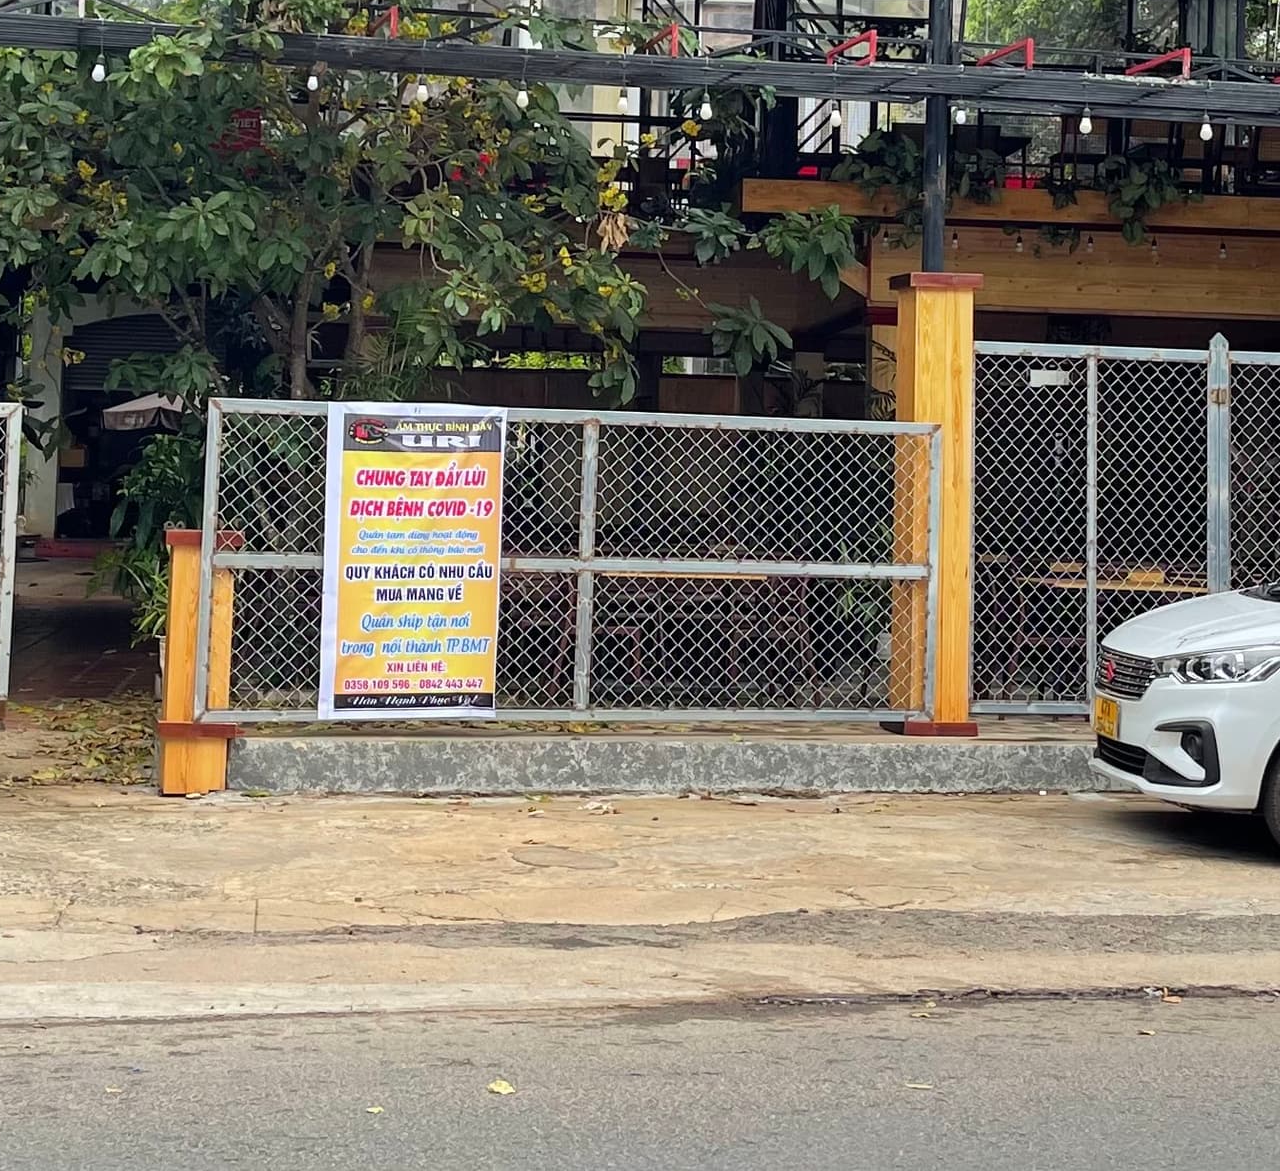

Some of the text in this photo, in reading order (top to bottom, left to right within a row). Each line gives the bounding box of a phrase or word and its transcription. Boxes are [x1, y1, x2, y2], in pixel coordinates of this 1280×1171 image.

[445, 421, 469, 432] BÌNH
[401, 435, 481, 448] URI
[356, 462, 486, 486] CHUNG TAY ĐẨY LÙI
[350, 500, 384, 521] DỊCH
[387, 497, 424, 521] BỆNH
[428, 501, 466, 517] COVID
[359, 529, 384, 540] Quán
[456, 530, 478, 541] động
[352, 545, 368, 554] cho
[390, 545, 405, 554] khi
[374, 564, 415, 579] KHÁCH
[419, 563, 435, 579] CÓ
[439, 566, 464, 579] NHU
[376, 588, 402, 601] MUA
[407, 588, 444, 601] MANG
[362, 613, 471, 631] Quán ship tận nơi
[342, 638, 490, 656] trong nội thành TP.BMT
[387, 662, 404, 672] XIN
[407, 660, 428, 672] LIÊN
[344, 679, 368, 690] 0358
[372, 679, 390, 690] 109
[420, 678, 442, 690] 0842
[445, 678, 463, 689] 443
[465, 678, 483, 689] 447
